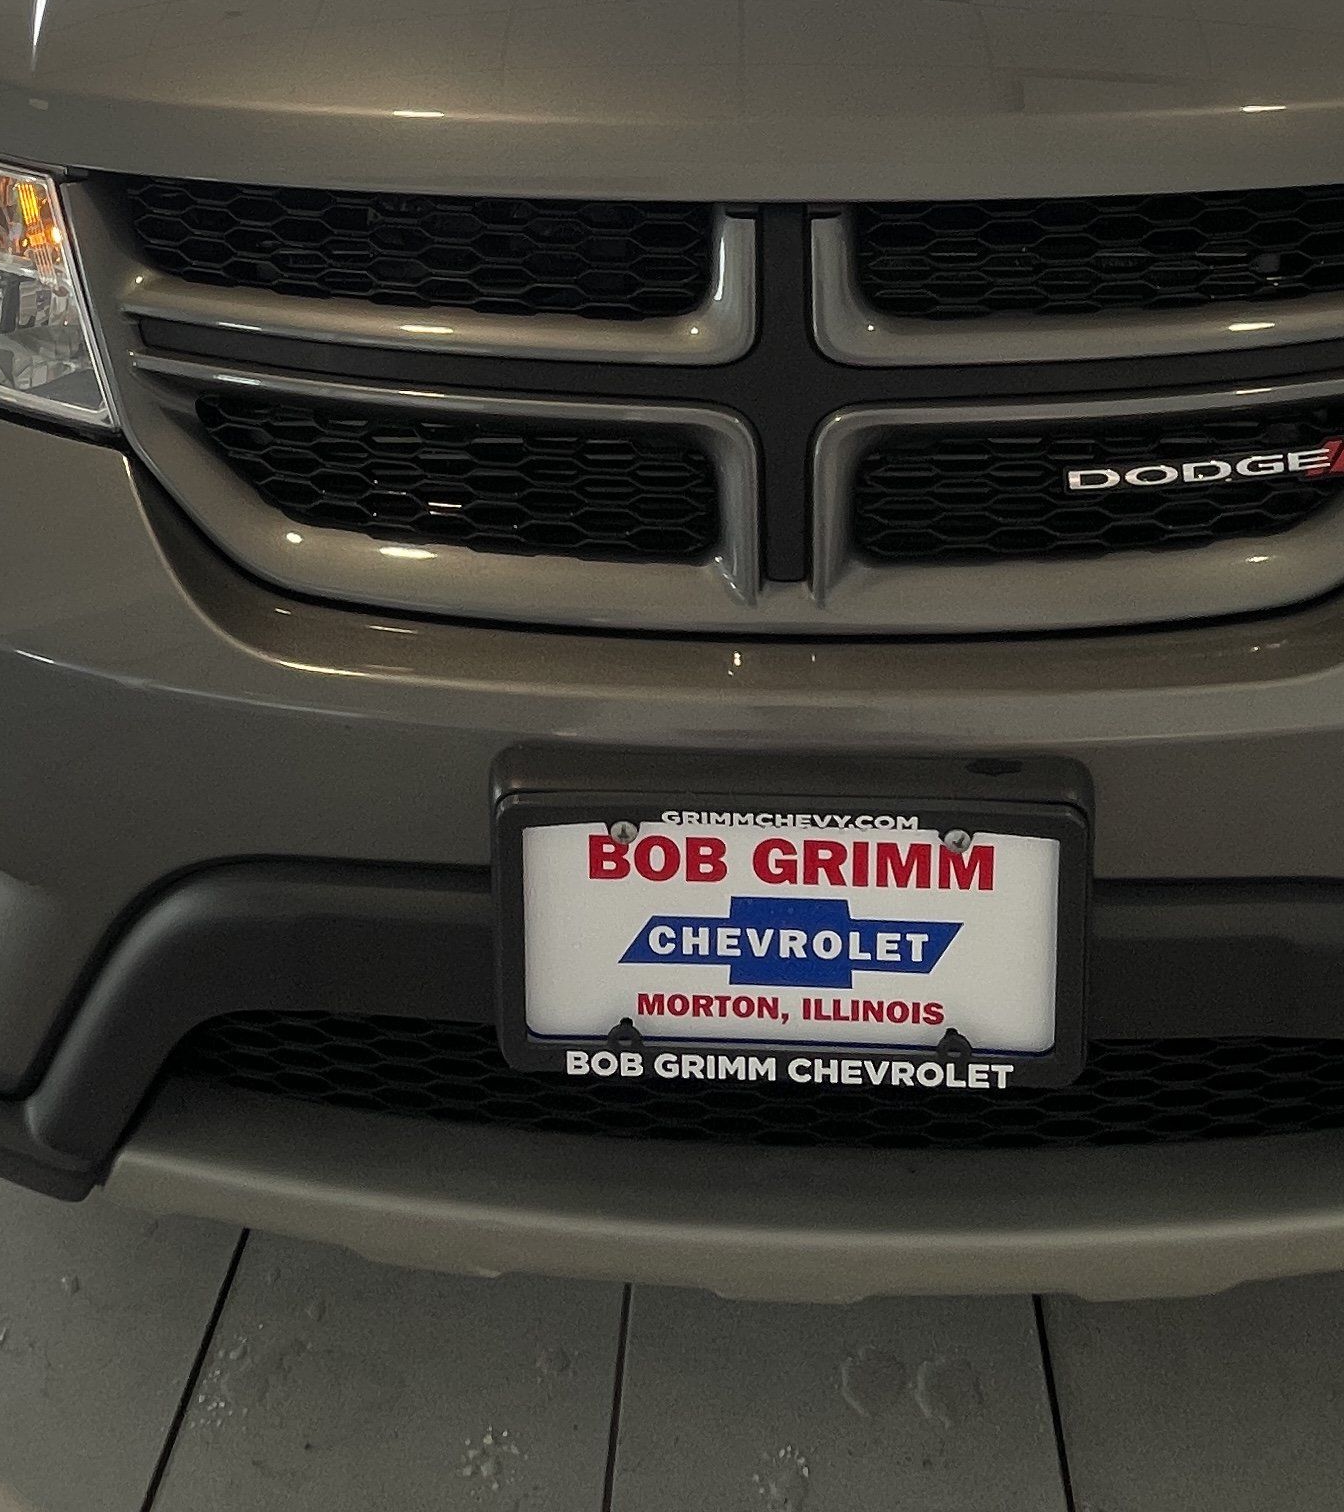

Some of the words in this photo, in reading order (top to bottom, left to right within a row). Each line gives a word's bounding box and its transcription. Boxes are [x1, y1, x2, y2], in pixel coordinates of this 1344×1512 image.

[1067, 448, 1332, 491] DODGE
[661, 809, 920, 832] GRIMMCHEVY.COM
[588, 834, 728, 883] BOB
[752, 837, 996, 891] GRIMM
[647, 923, 931, 964] CHEVROLET
[636, 993, 791, 1025] MORTON,
[802, 998, 945, 1026] ILLINOIS
[566, 1050, 645, 1078] BOB
[653, 1053, 778, 1083] GRIMM
[788, 1058, 1015, 1090] CHEVROLET
